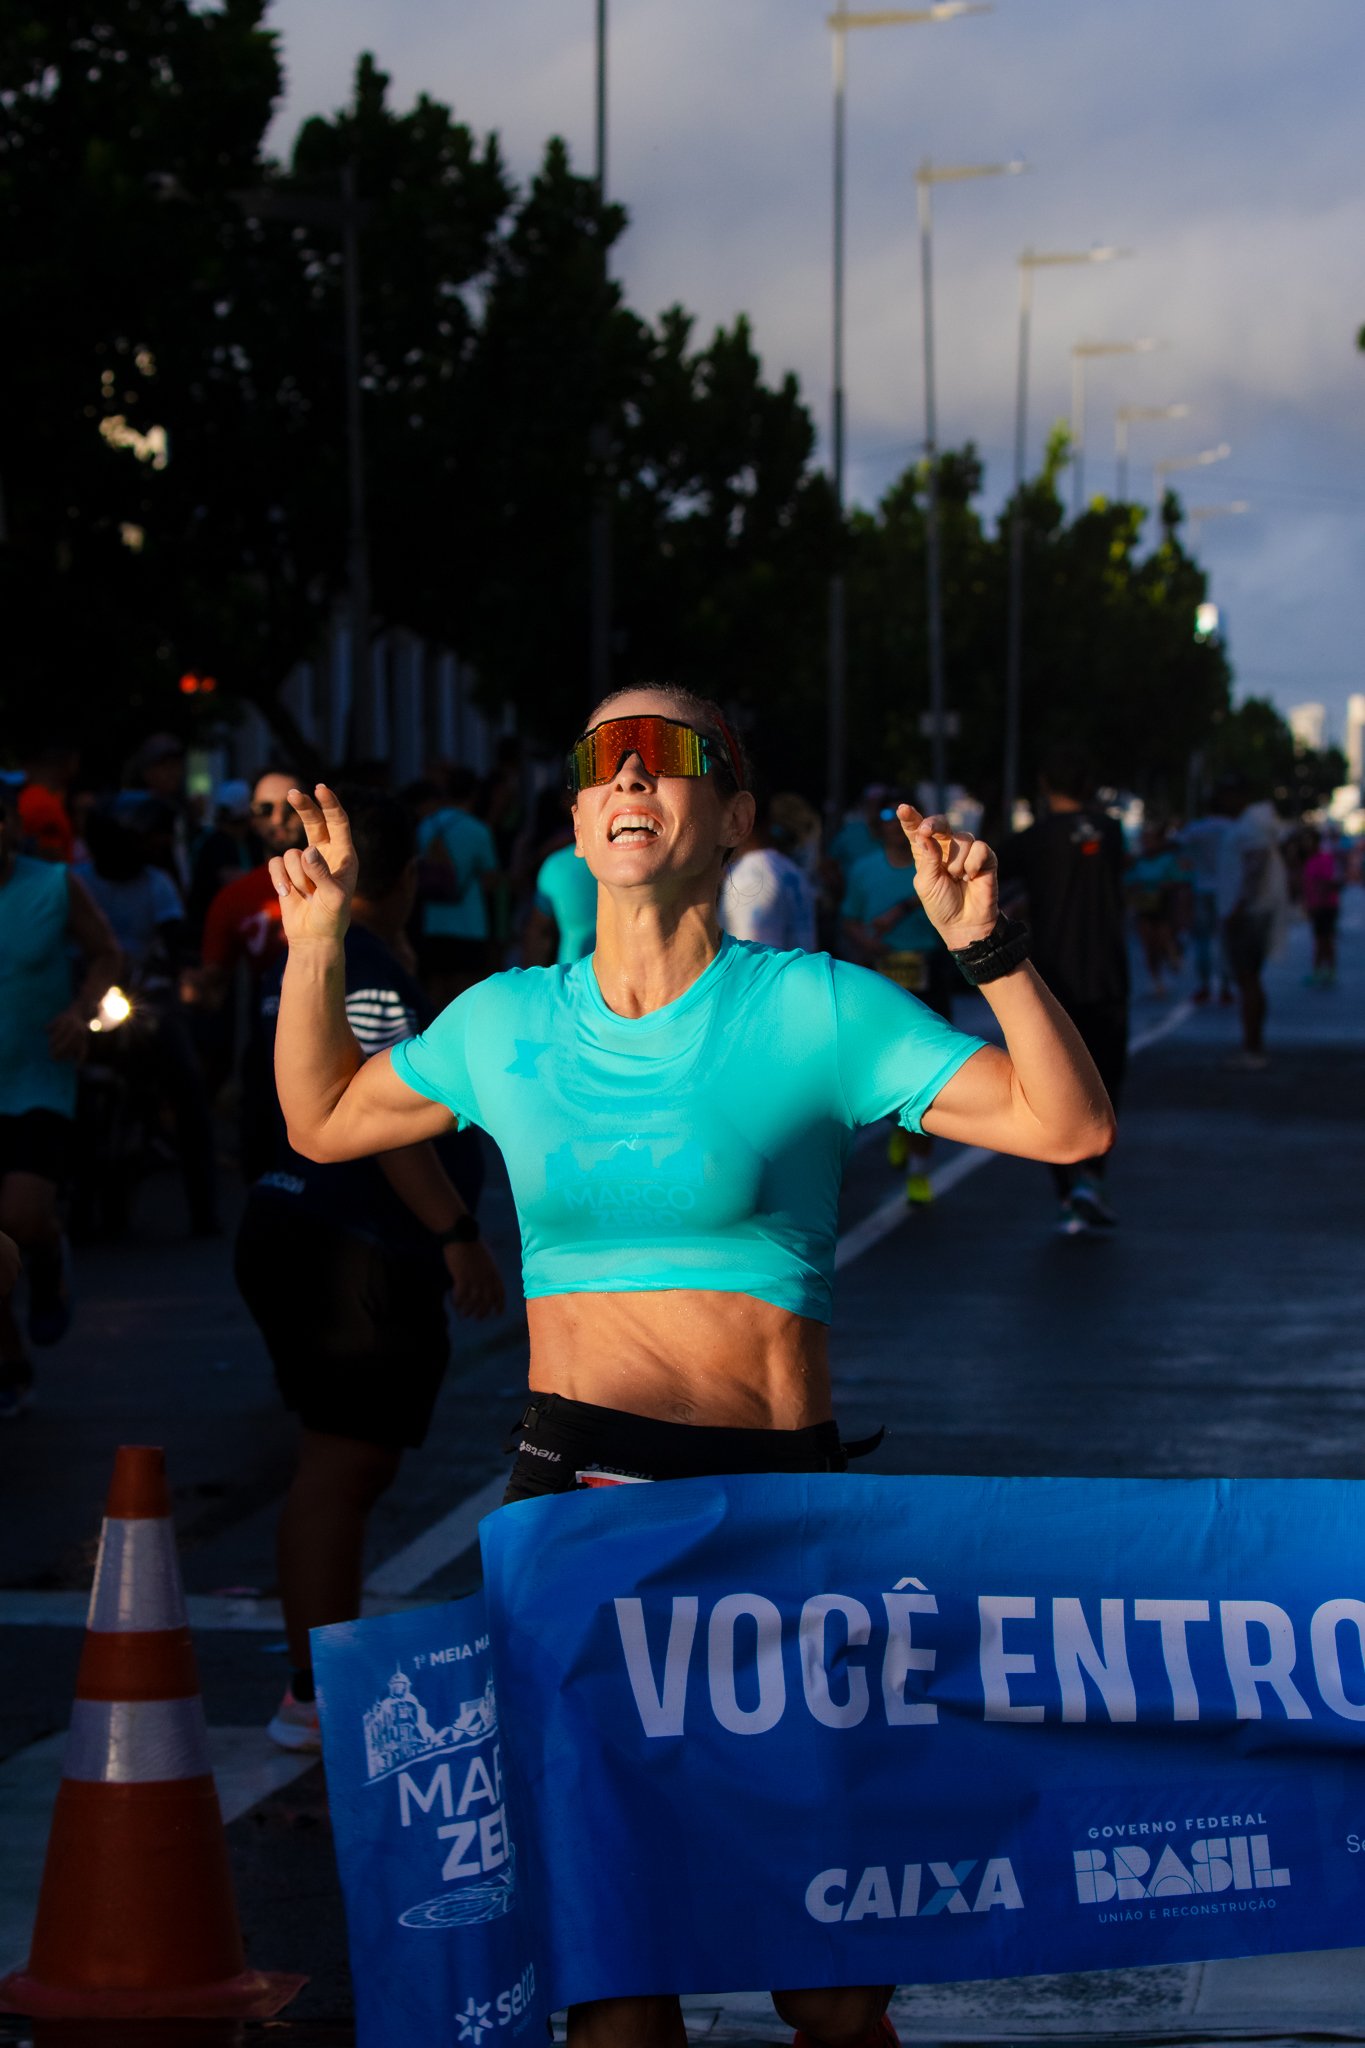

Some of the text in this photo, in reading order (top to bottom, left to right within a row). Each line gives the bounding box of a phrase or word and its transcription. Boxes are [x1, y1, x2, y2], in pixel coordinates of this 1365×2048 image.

[563, 1184, 696, 1211] MARCO
[590, 1208, 683, 1229] ZERO
[429, 1644, 473, 1667] MEIA
[614, 1577, 1365, 1738] VOCÊ ENTRO
[1087, 1812, 1267, 1839] GOVERNO FEDERAL
[437, 1801, 509, 1882] ZE
[1346, 1834, 1365, 1853] S
[1072, 1834, 1292, 1904] BRASIL
[804, 1856, 1025, 1923] CAIXA
[1098, 1898, 1278, 1924] UNIÃO E RECONSTRUÇÃO
